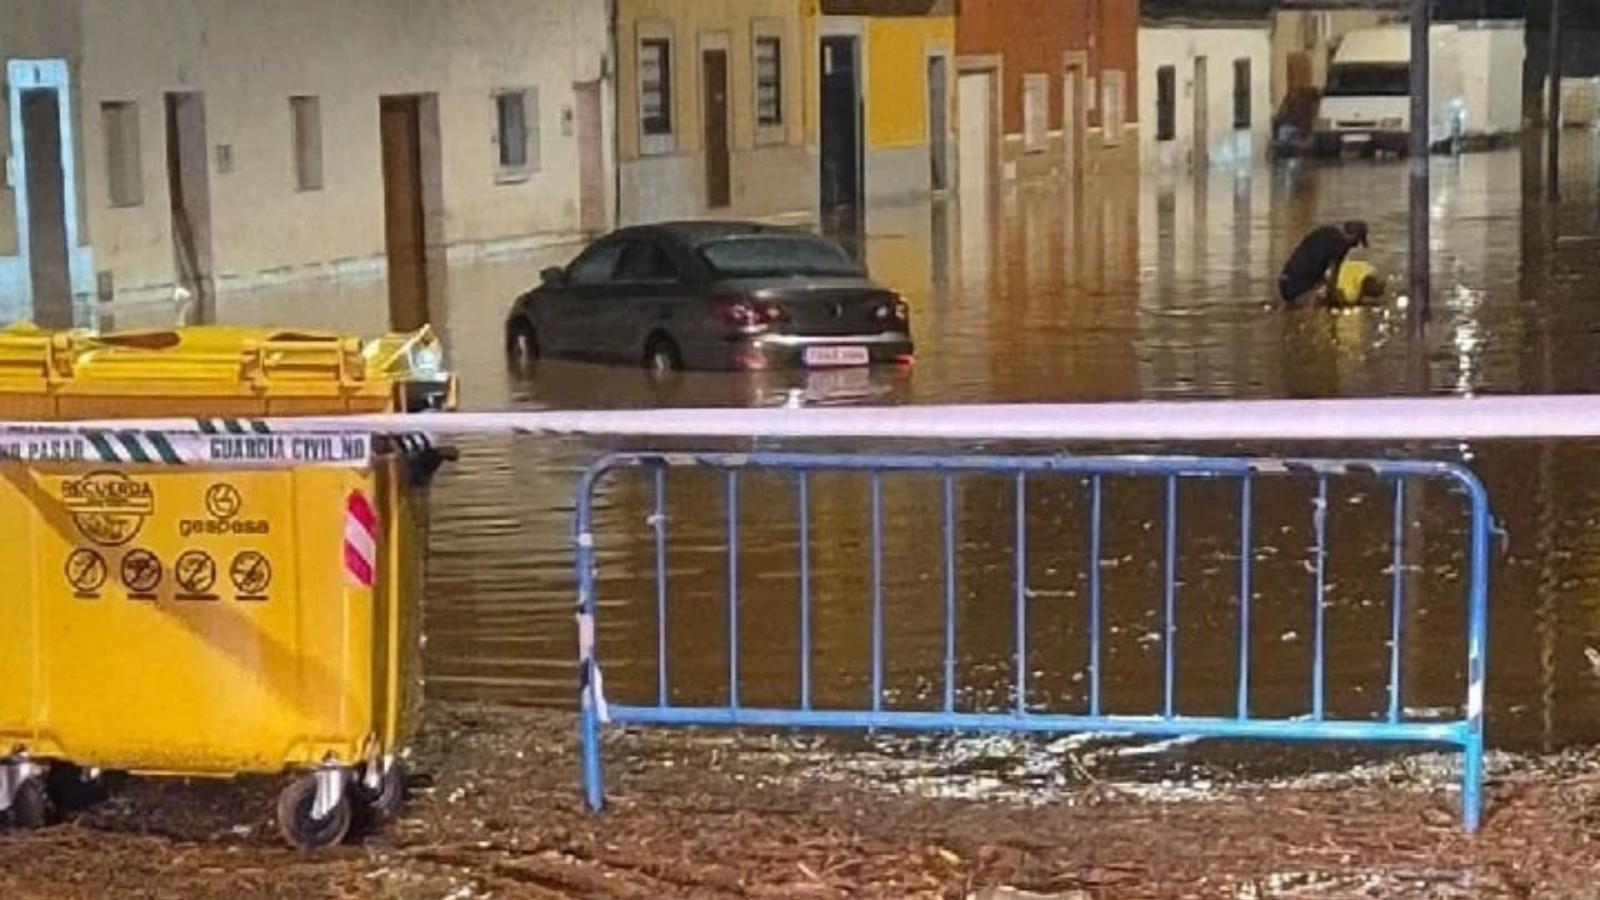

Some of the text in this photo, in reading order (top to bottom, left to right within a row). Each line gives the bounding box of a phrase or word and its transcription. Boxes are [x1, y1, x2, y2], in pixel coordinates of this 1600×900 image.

[29, 440, 83, 459] PASAR
[210, 436, 365, 460] GUARDIA CIVIL NO
[62, 480, 150, 497] RECUERDA
